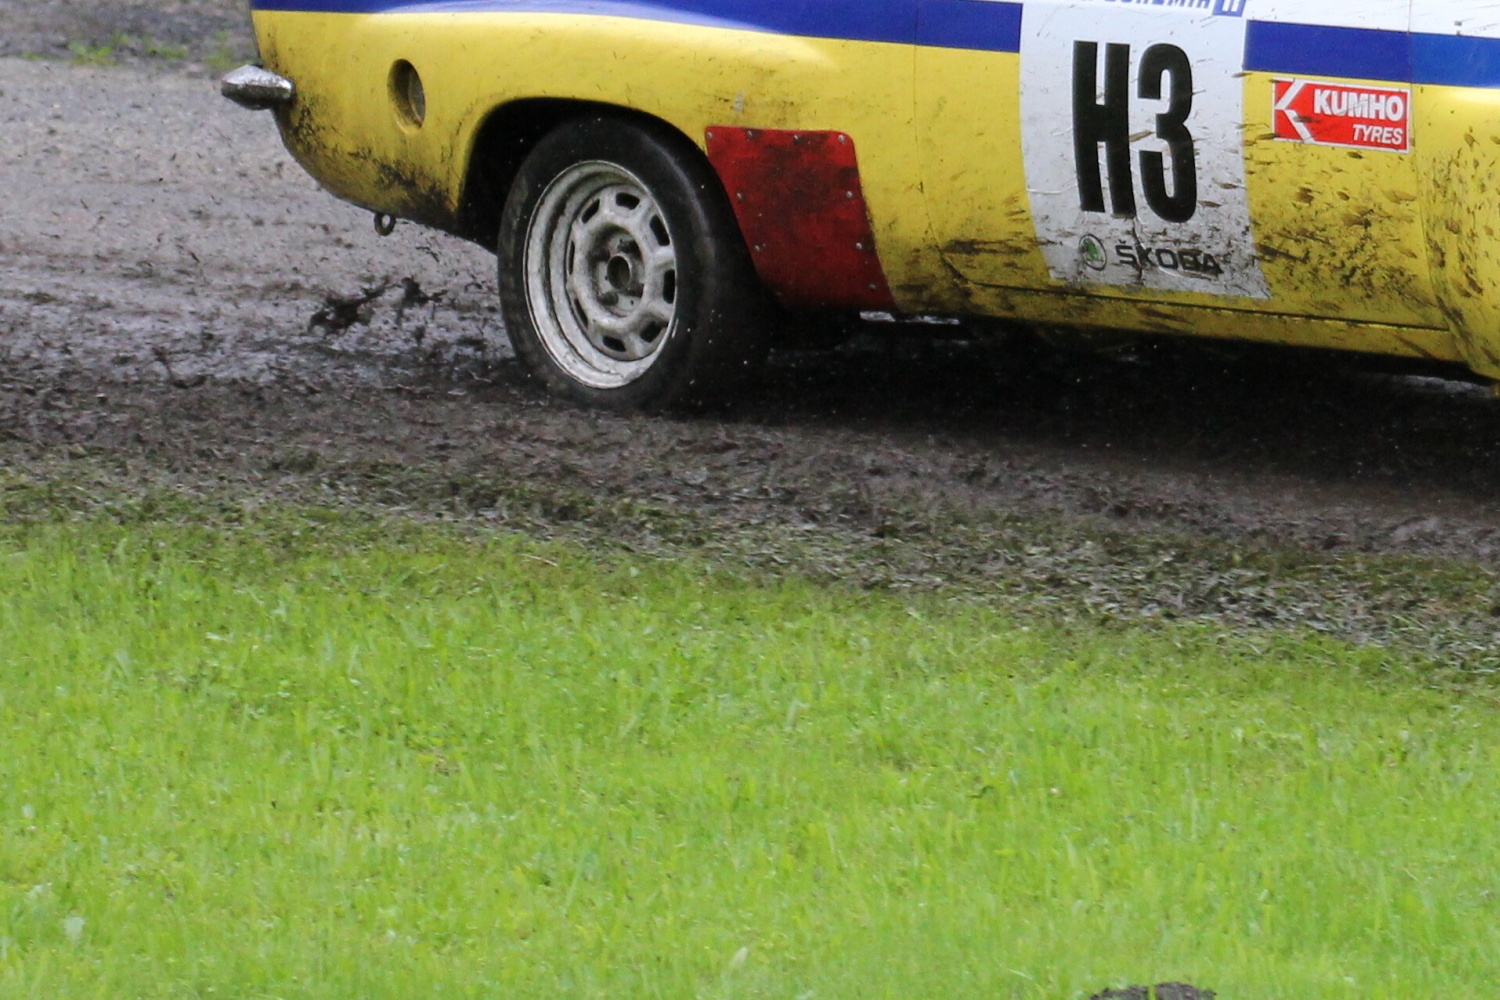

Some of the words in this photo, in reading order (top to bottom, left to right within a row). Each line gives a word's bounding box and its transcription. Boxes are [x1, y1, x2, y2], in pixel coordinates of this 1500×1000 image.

[1313, 88, 1404, 122] KUMHO
[1072, 40, 1198, 224] H3
[1352, 123, 1403, 145] TYRES
